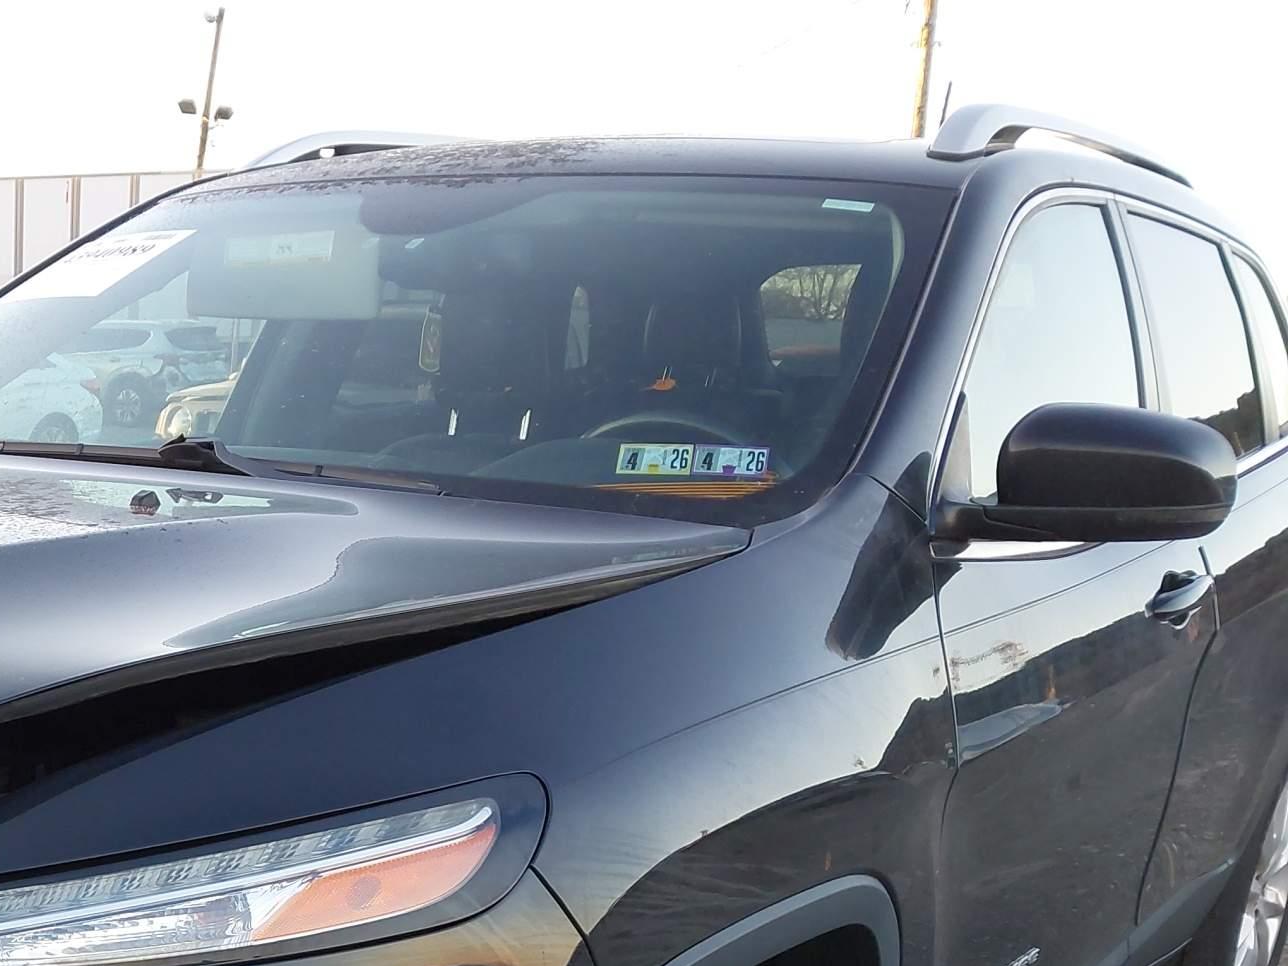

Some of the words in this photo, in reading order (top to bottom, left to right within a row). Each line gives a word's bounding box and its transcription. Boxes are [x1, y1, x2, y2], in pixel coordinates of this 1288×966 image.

[626, 452, 638, 470] 4
[670, 449, 689, 469] 26
[700, 452, 714, 470] 4
[745, 451, 765, 472] 26
